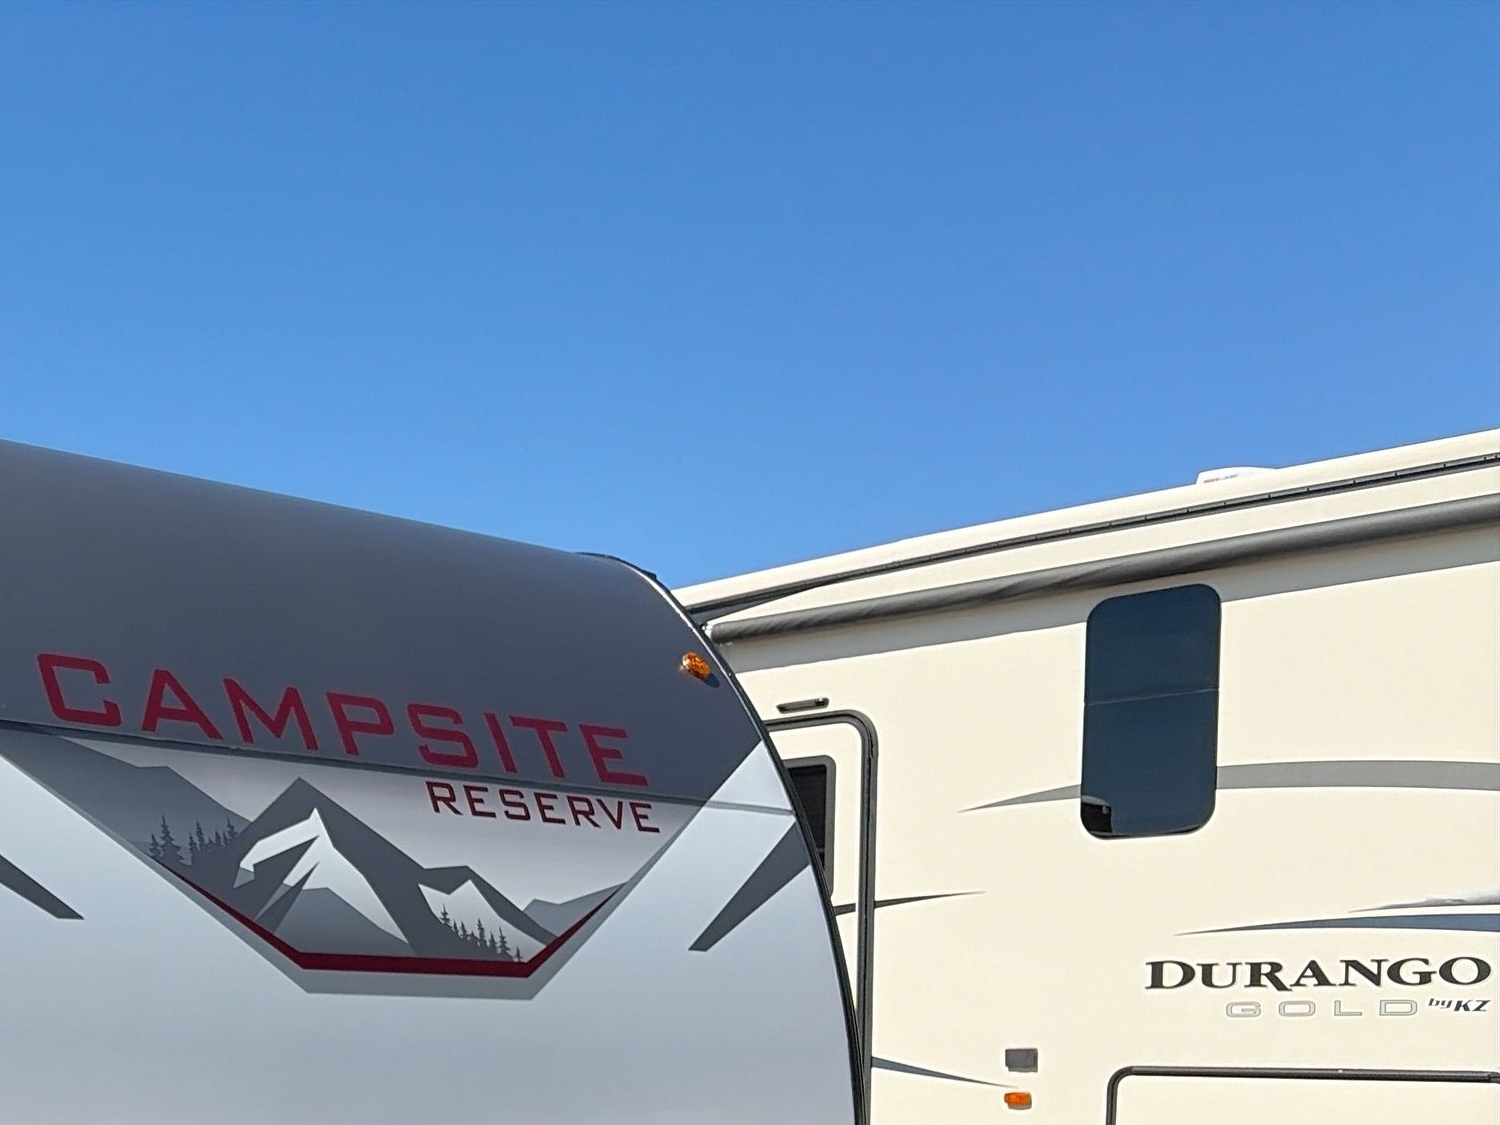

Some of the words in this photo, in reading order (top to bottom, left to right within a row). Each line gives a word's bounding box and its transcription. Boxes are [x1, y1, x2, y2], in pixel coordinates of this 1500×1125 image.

[36, 652, 649, 788] CAMPSITE
[424, 780, 661, 834] RESERVE
[1144, 956, 1492, 992] DURANGO
[1225, 998, 1419, 1018] GOLD
